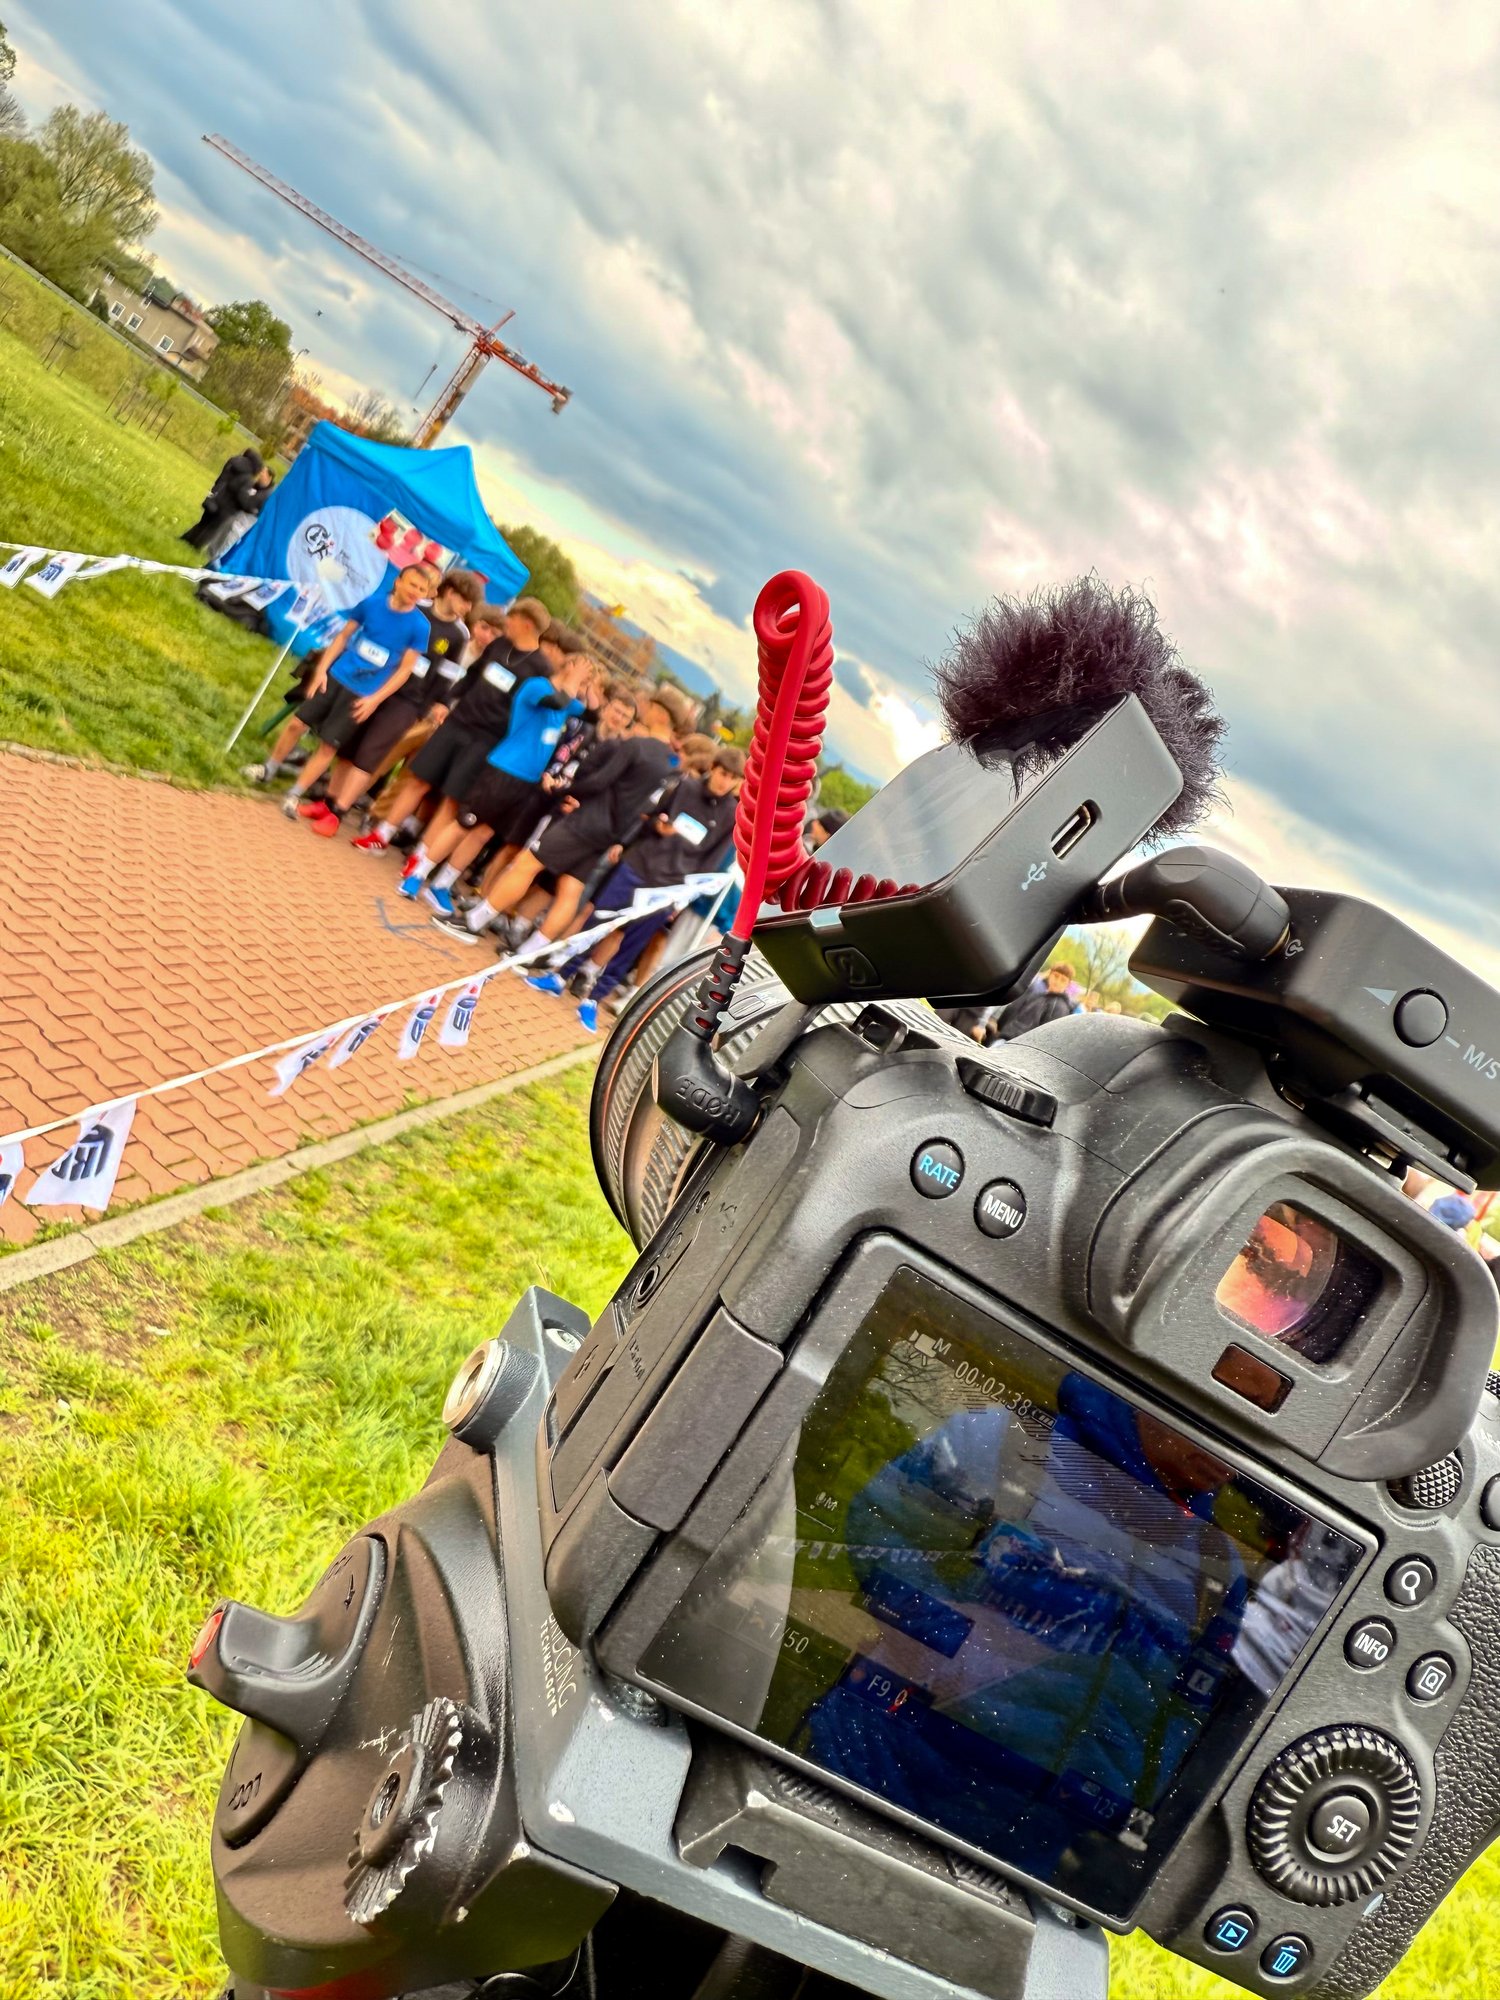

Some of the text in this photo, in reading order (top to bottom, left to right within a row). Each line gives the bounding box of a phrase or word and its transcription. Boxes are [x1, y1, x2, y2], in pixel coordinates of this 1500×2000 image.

[1462, 1043, 1500, 1080] M/S
[918, 1153, 961, 1190] RATE
[982, 1193, 1024, 1230] MENU
[954, 1360, 1033, 1417] 00:02:38
[768, 1621, 810, 1654] 1/50
[1353, 1631, 1390, 1662] INFO
[866, 1673, 909, 1708] F9.0
[1424, 1671, 1440, 1690] Q
[1093, 1797, 1120, 1820] 125
[1325, 1814, 1362, 1843] SET
